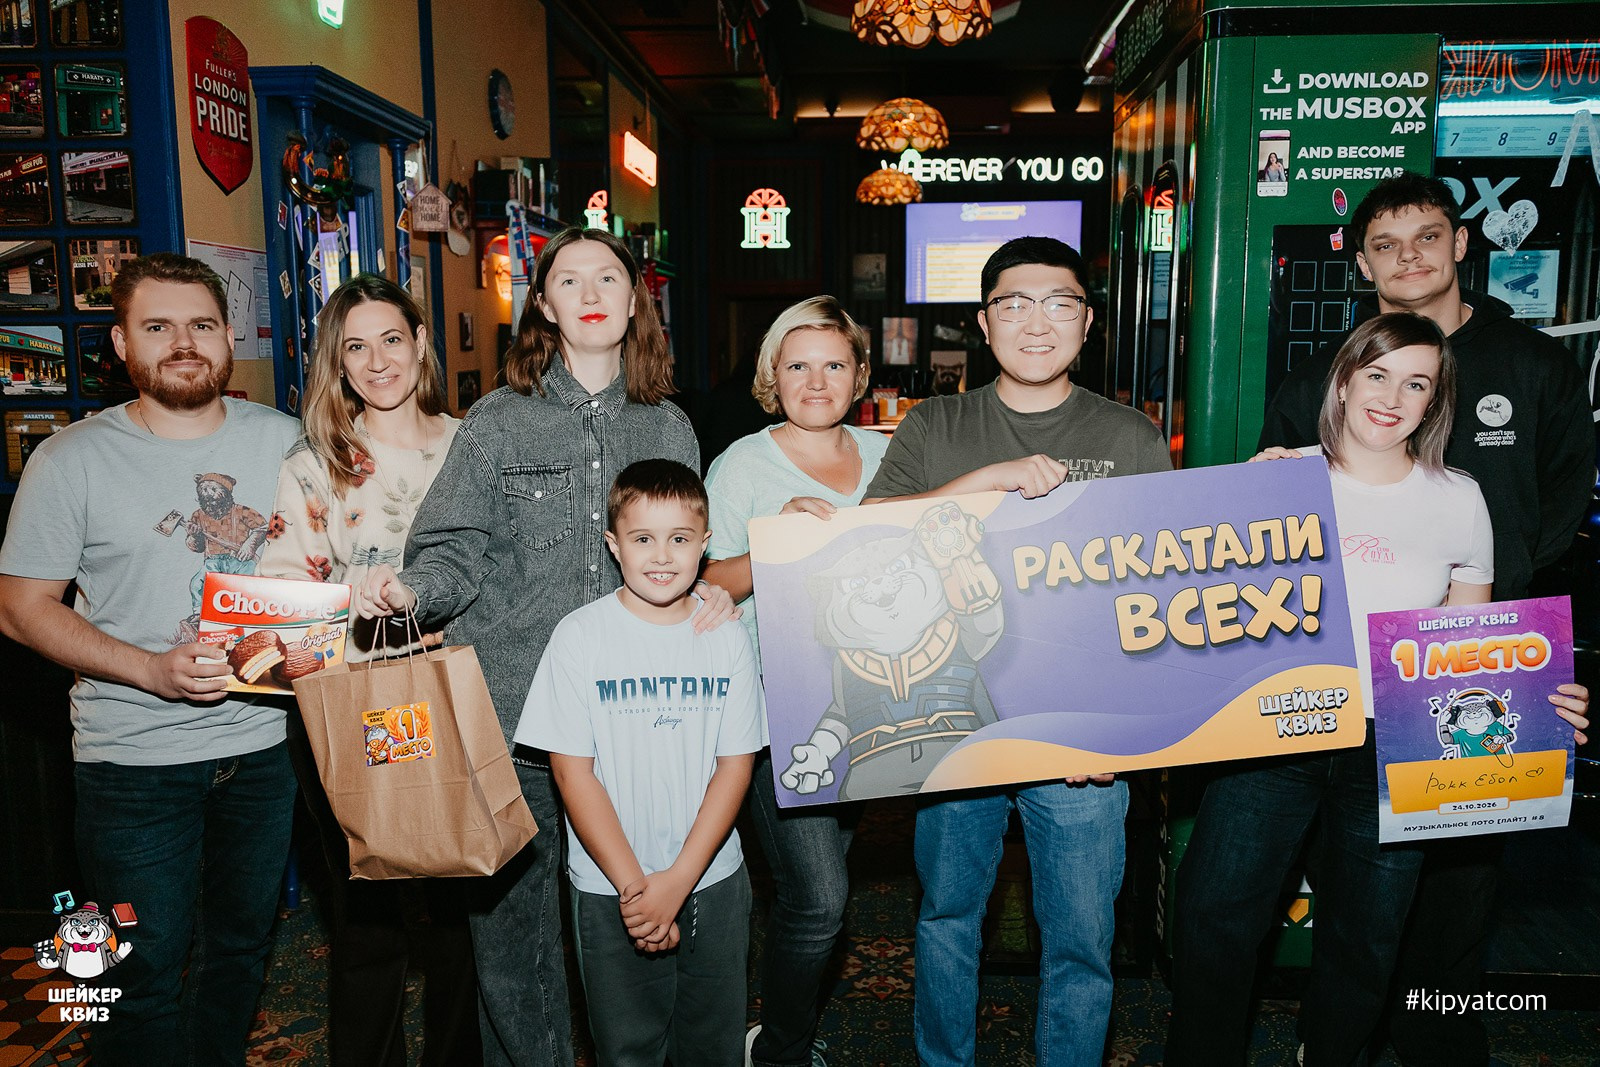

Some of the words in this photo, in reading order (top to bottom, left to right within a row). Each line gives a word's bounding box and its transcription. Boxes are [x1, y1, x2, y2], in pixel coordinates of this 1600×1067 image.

[205, 59, 237, 82] FULLER'S
[1298, 72, 1429, 90] DOWNLOAD
[194, 73, 247, 107] LONDON
[196, 95, 249, 142] PRIDE
[1260, 107, 1293, 121] THE
[1297, 96, 1427, 120] MUSBOX
[1390, 121, 1427, 135] APP
[1547, 131, 1558, 146] 9
[1450, 132, 1460, 147] 7
[1498, 132, 1509, 146] 8
[1296, 146, 1334, 159] AND
[1337, 145, 1405, 159] BECOME
[1017, 157, 1063, 182] YOU
[1071, 156, 1104, 182] GO
[1294, 168, 1308, 180] A
[420, 196, 440, 204] HOME
[421, 213, 441, 222] HOME
[1012, 513, 1325, 592] РАСКАТАЛИ
[1114, 574, 1323, 654] ВСЕХ!
[1418, 617, 1475, 632] ШЕЙКЕР
[1479, 612, 1519, 626] КВИЗ
[301, 628, 342, 650] Original
[1393, 641, 1417, 679] 1
[1426, 634, 1549, 677] МЕСТО
[1258, 686, 1349, 716] ШЕЙКЕР
[400, 709, 415, 740] 1
[1276, 713, 1338, 738] КВИЗ
[391, 738, 432, 759] МЕСТО
[1452, 802, 1497, 811] 24.10.2026
[1403, 821, 1469, 832] МУЗЫКАЛЬНОЕ
[1497, 816, 1527, 825] [ЛАЙТ]
